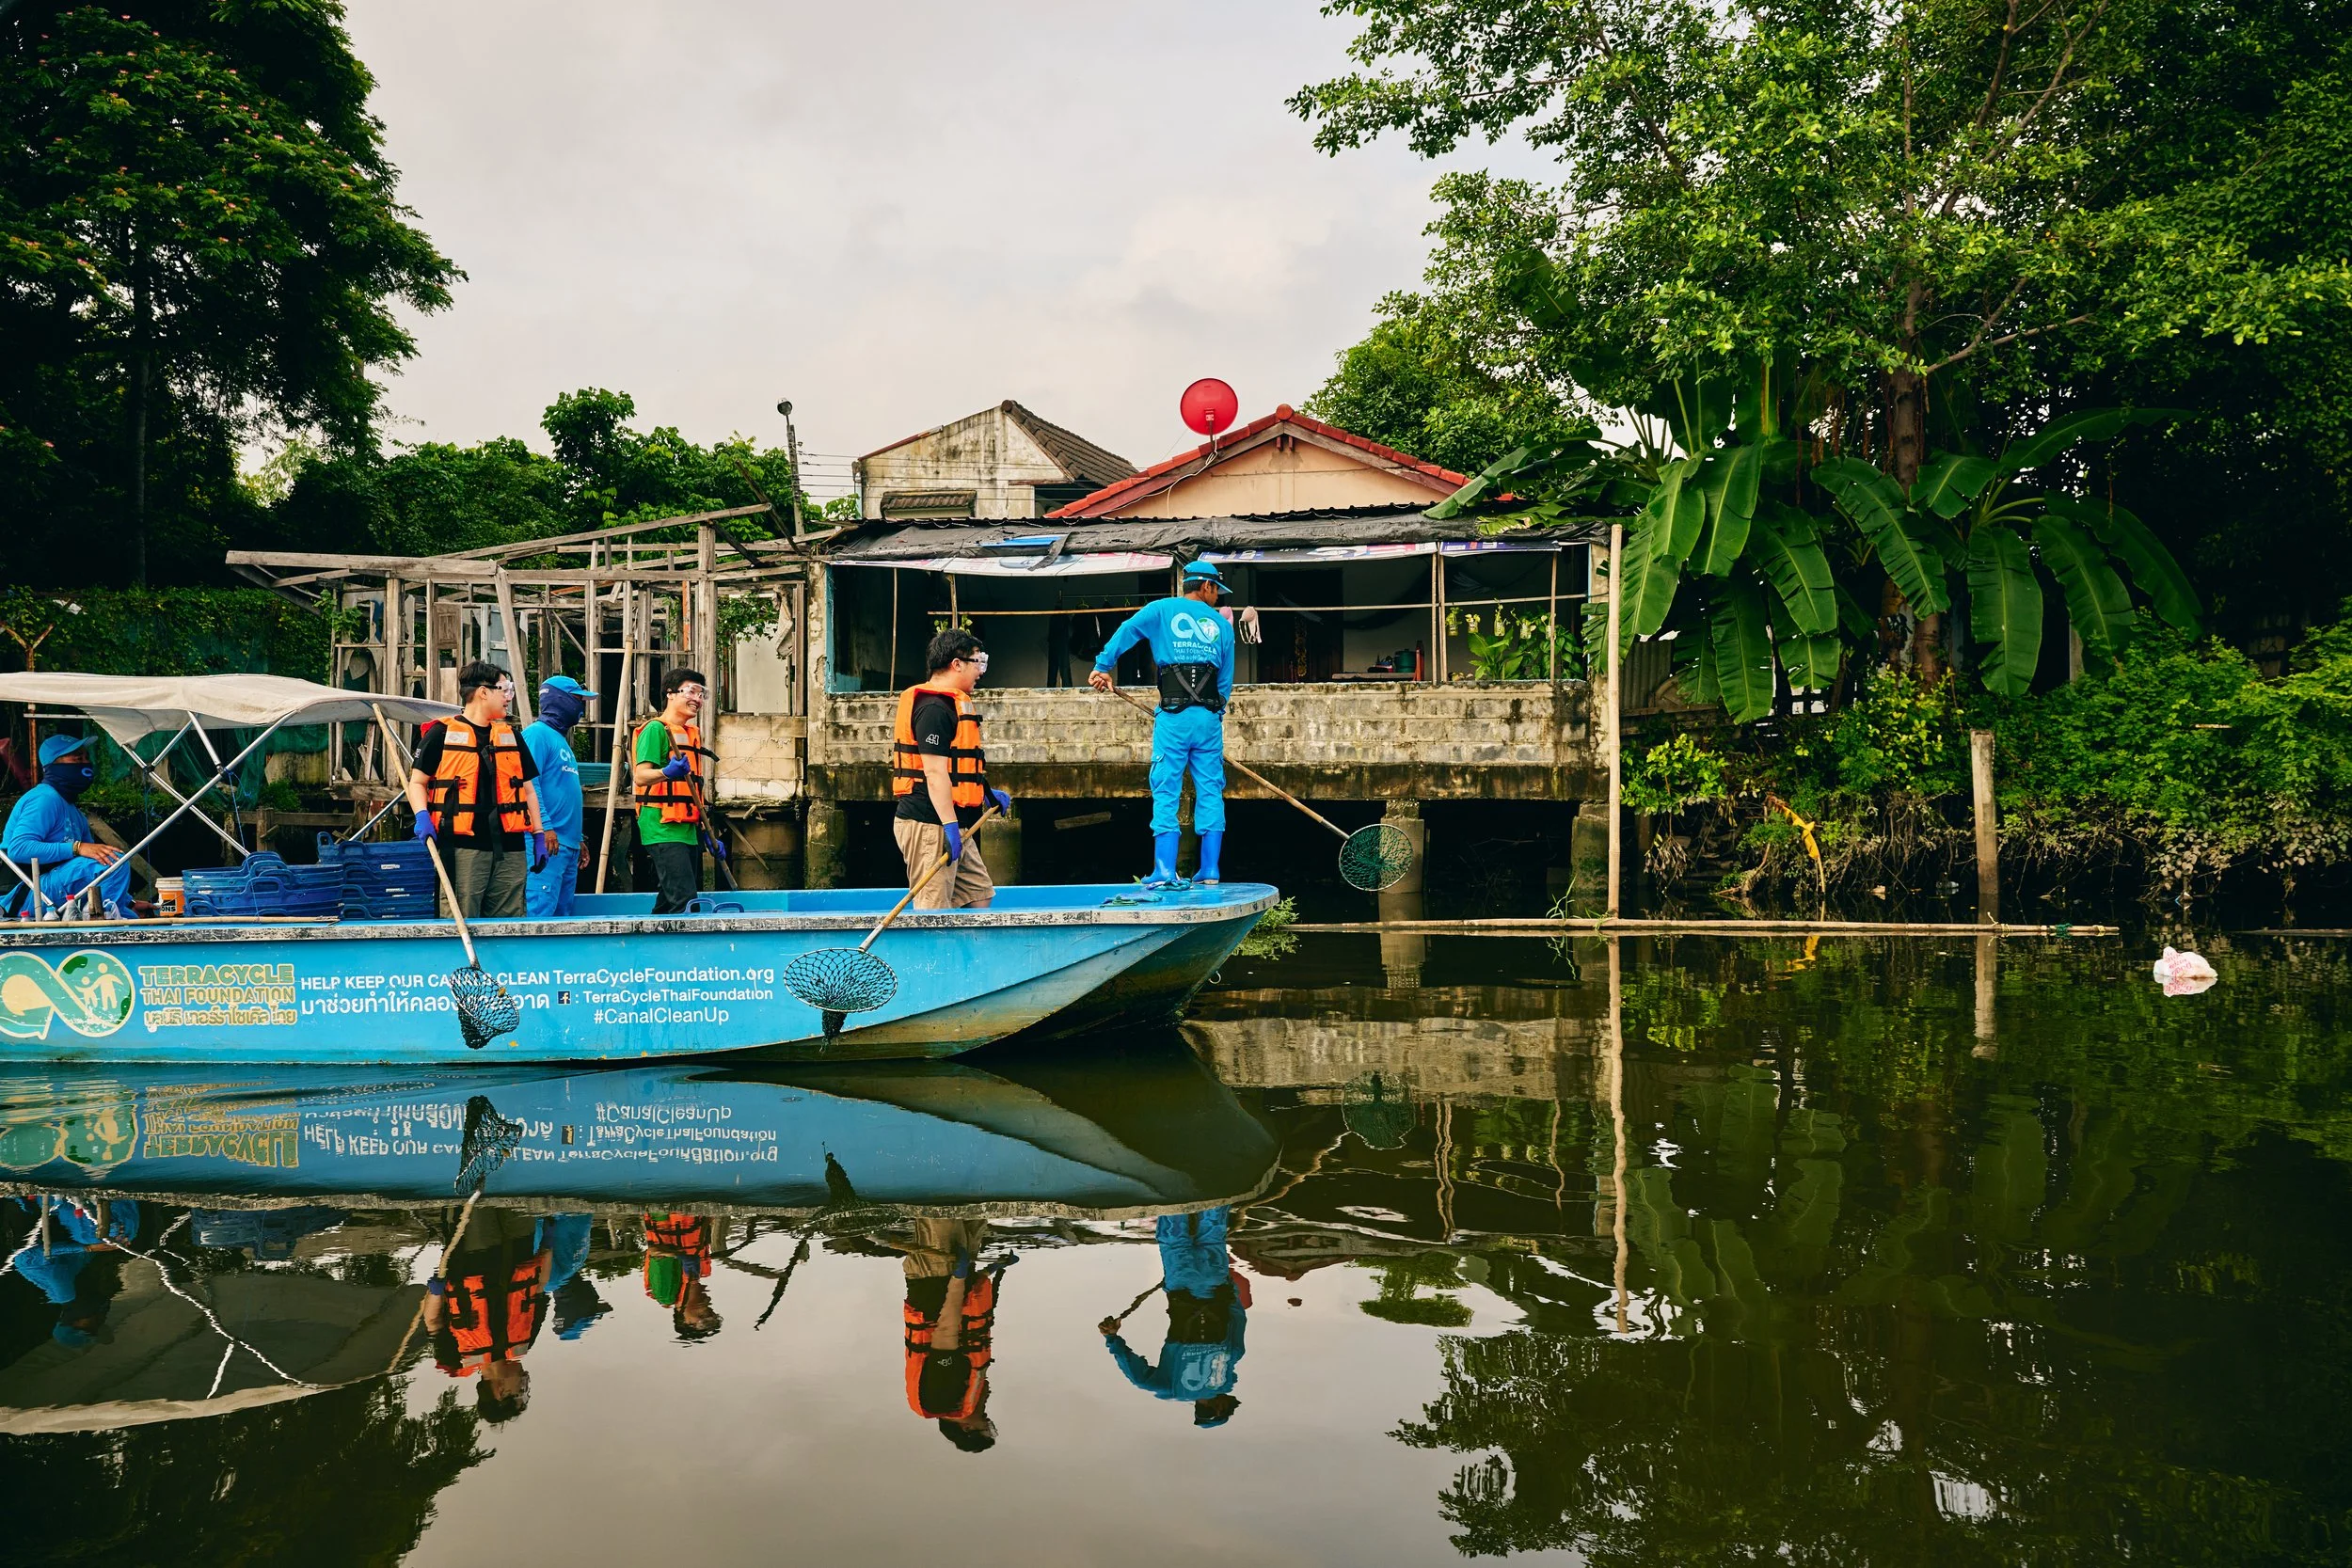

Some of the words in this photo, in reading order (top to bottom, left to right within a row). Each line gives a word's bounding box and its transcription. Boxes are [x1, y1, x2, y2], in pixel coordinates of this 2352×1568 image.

[139, 964, 295, 987] TERRACYCLE
[301, 975, 341, 990] HELP
[344, 974, 386, 990] KEEP
[389, 974, 424, 989] OUR
[496, 971, 550, 986] CLEAN
[552, 967, 774, 988] TerraCycleFoundation.org
[140, 988, 182, 1005] THAI
[184, 986, 296, 1005] FOUNDATION
[582, 988, 773, 1006] TerraCycleThaiFoundation
[594, 1006, 730, 1025] #CanalCleanUp
